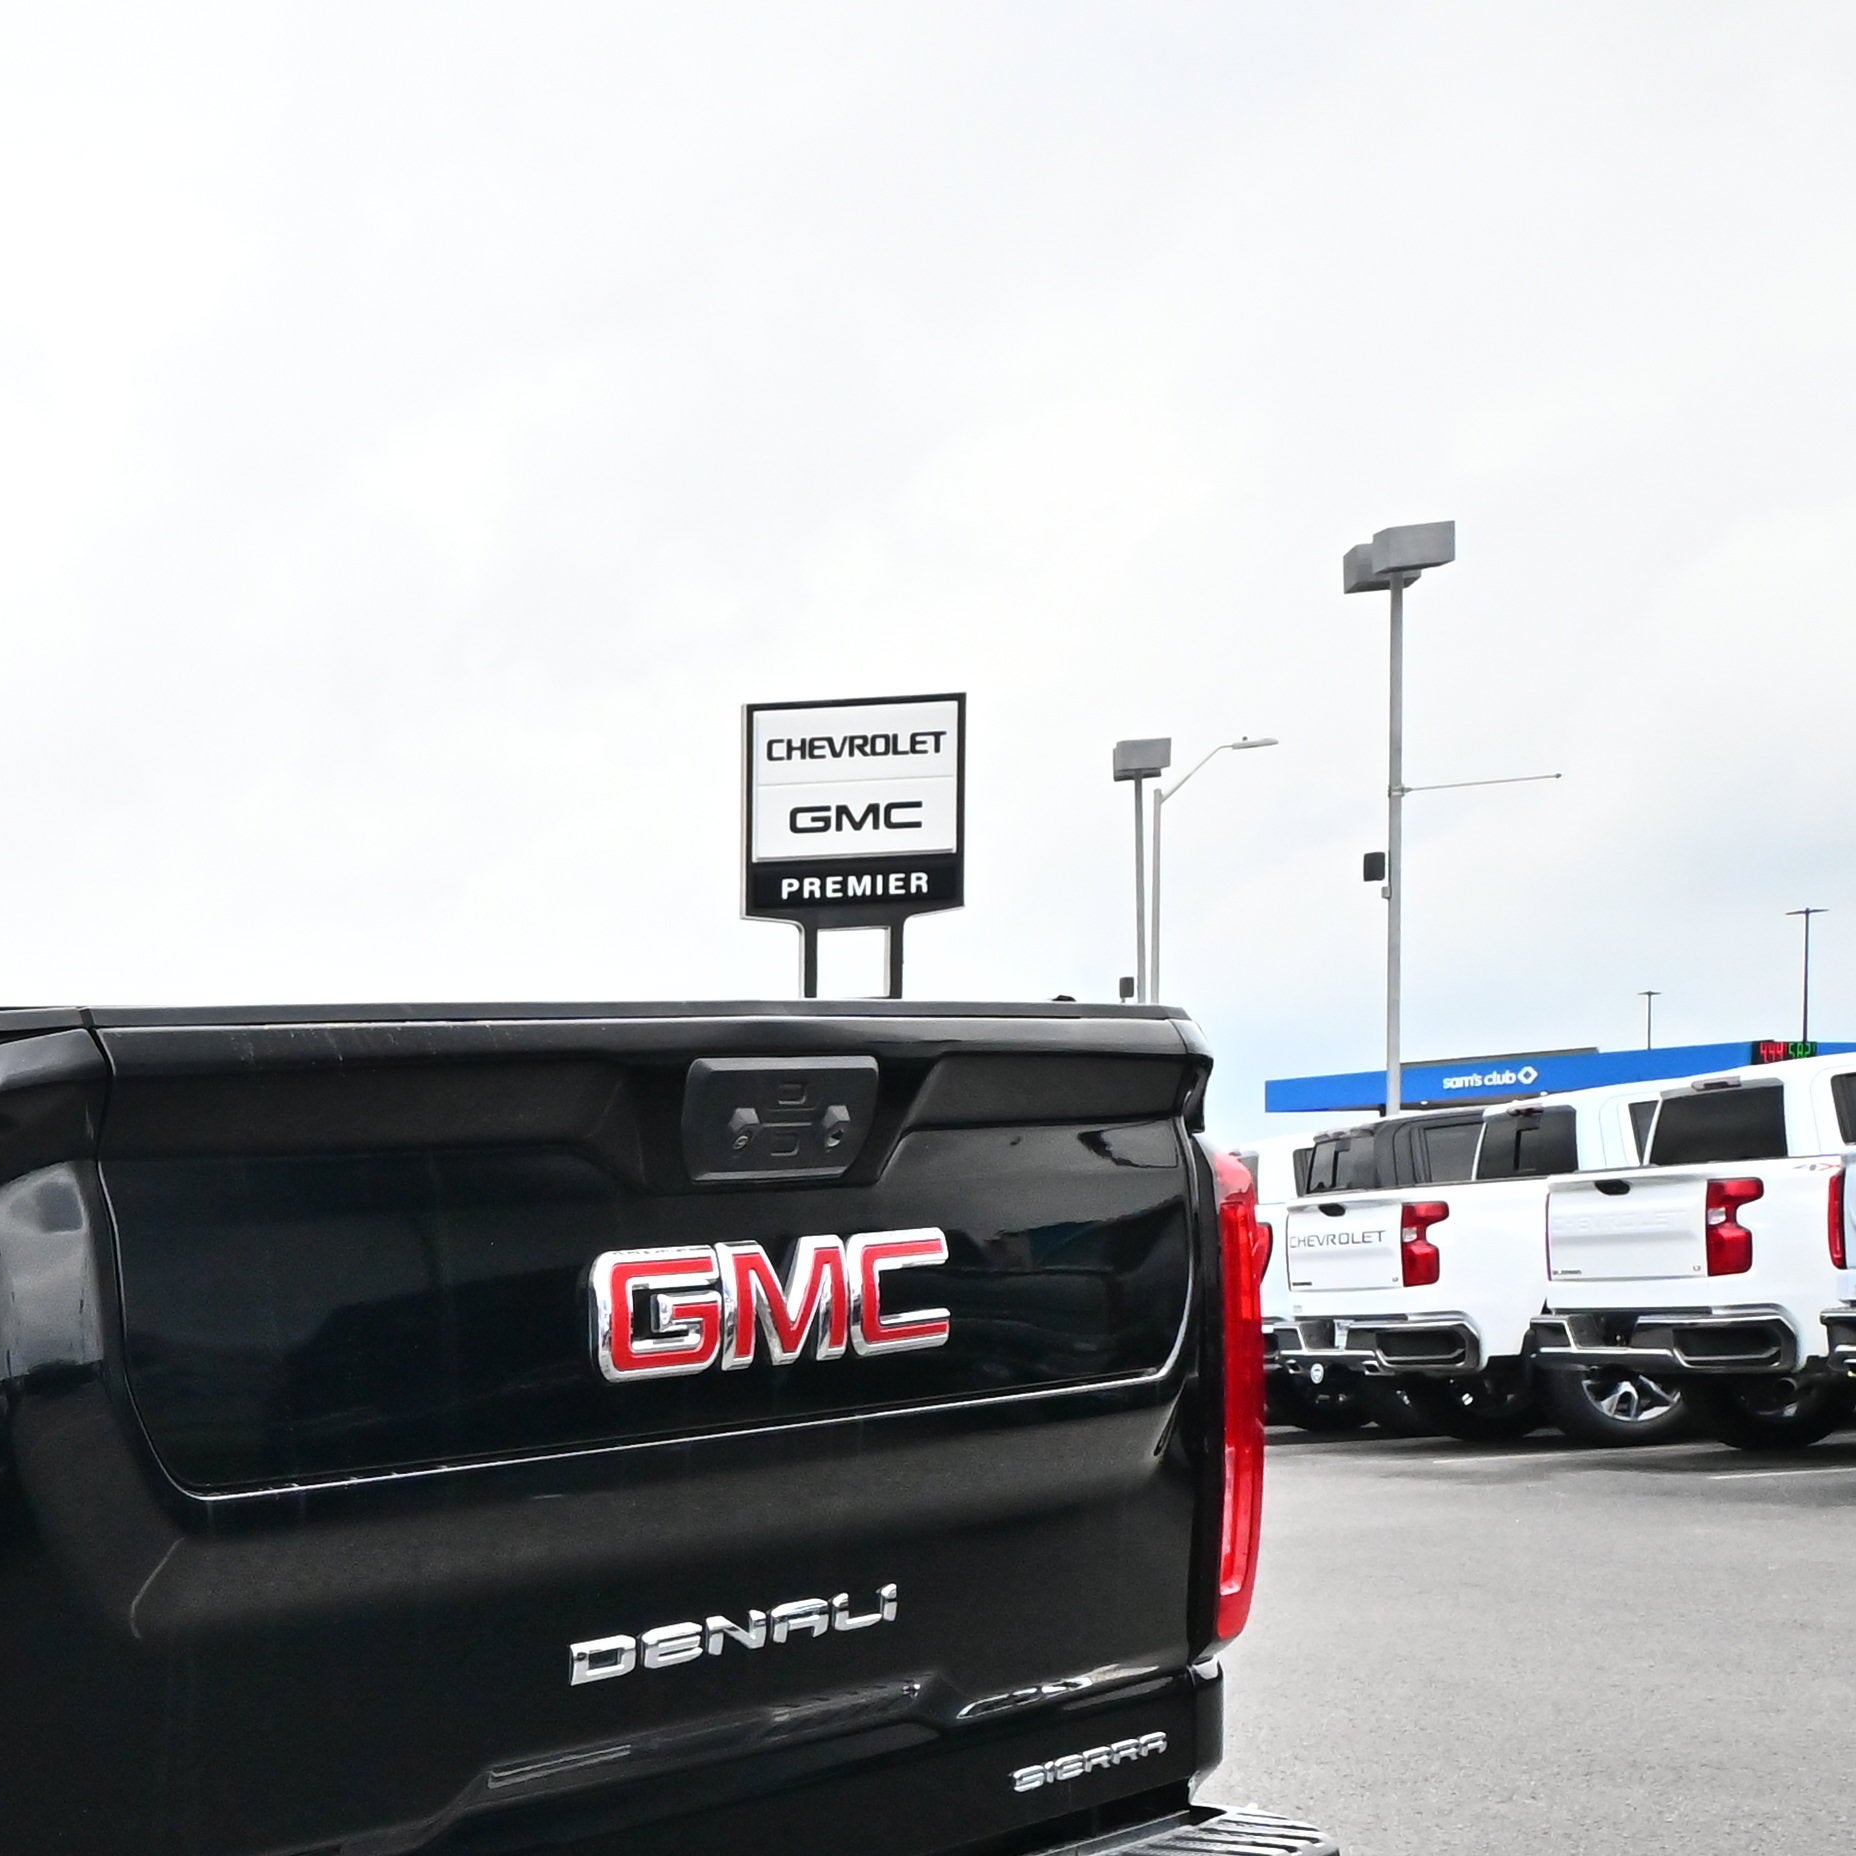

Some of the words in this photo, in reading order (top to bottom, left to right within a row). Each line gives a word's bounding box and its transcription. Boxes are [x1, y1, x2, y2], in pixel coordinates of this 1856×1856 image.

[766, 731, 947, 762] CHEVROLET
[789, 800, 923, 834] GMC
[781, 872, 929, 900] PREMIER
[1442, 1073, 1483, 1089] sam's
[1483, 1070, 1517, 1086] club
[1289, 1229, 1386, 1249] CHEVROLET
[590, 1226, 951, 1383] GMC
[569, 1583, 898, 1686] DENALI
[1010, 1731, 1168, 1793] SIERRA
